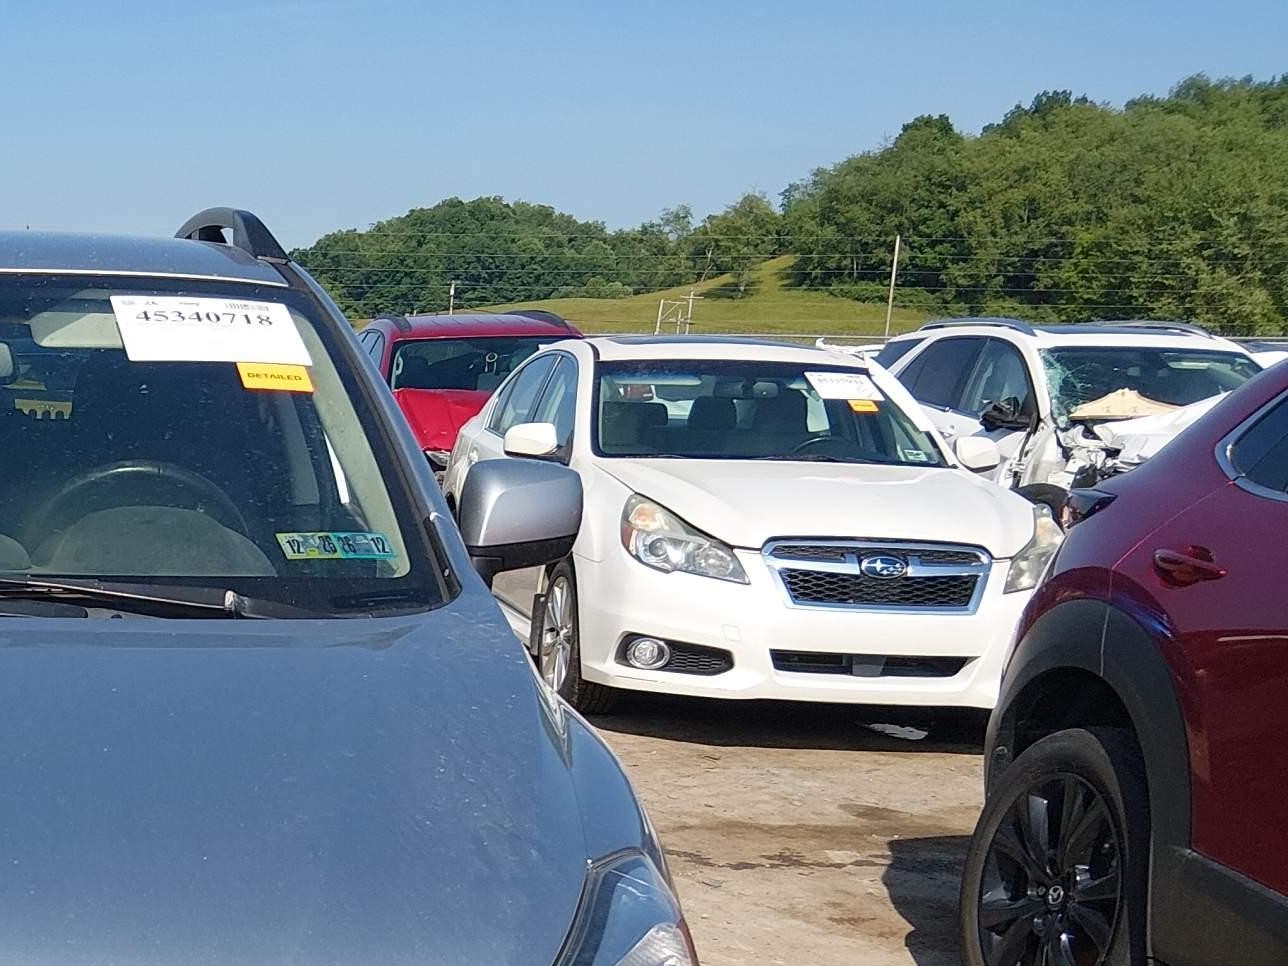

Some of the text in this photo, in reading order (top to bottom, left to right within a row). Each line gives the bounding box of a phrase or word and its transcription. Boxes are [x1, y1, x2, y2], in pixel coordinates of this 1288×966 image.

[135, 310, 273, 326] 45340718
[247, 372, 303, 381] DETAILED
[287, 535, 337, 554] 12 26
[337, 536, 390, 553] 26 12
